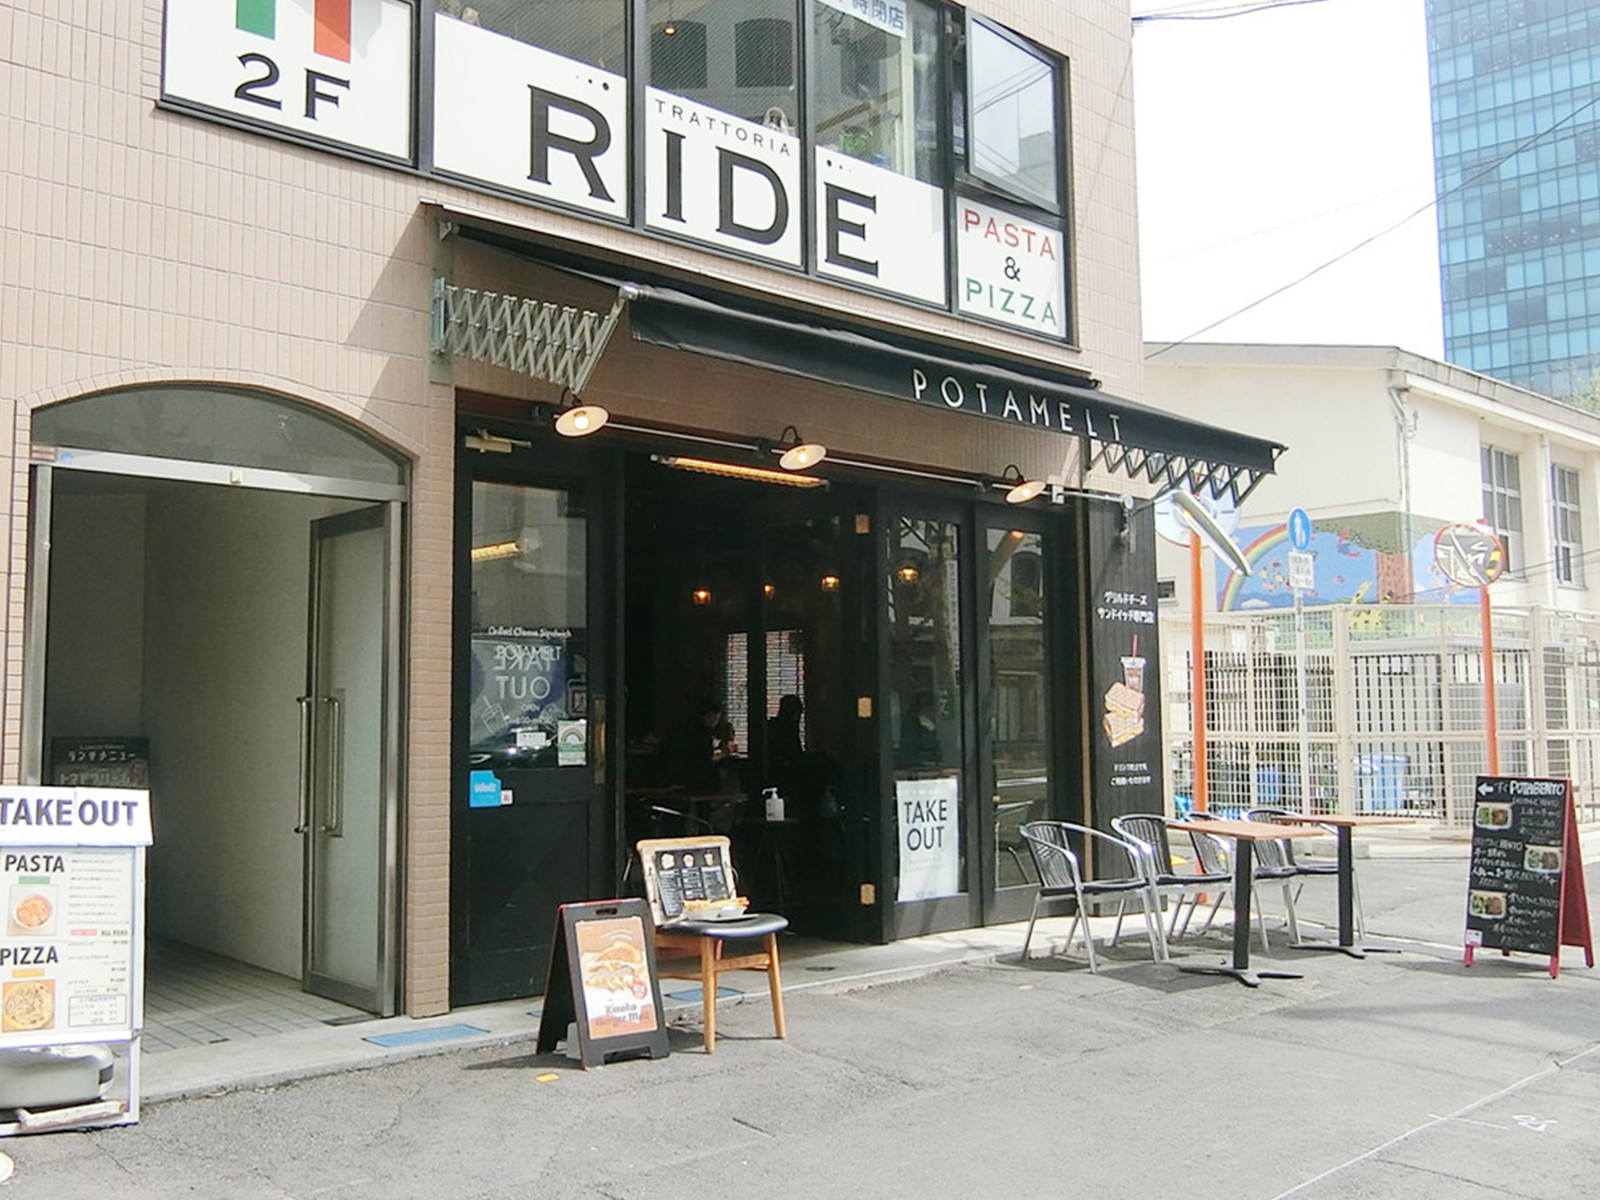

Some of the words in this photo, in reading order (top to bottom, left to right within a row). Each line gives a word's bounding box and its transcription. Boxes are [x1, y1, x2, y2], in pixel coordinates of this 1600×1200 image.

[850, 0, 904, 30] 時閉店
[235, 52, 351, 120] 2F
[655, 98, 791, 157] TRATTORIA
[964, 208, 1056, 262] PASTA
[1004, 256, 1021, 282] &
[966, 277, 1057, 326] PIZZA
[913, 369, 1120, 442] POTAMELT
[0, 798, 73, 826] TAKE
[78, 799, 138, 826] OUT
[904, 799, 947, 824] TAKE
[906, 826, 944, 851] OUT
[5, 855, 65, 872] PASTA
[0, 946, 58, 965] PIZZA
